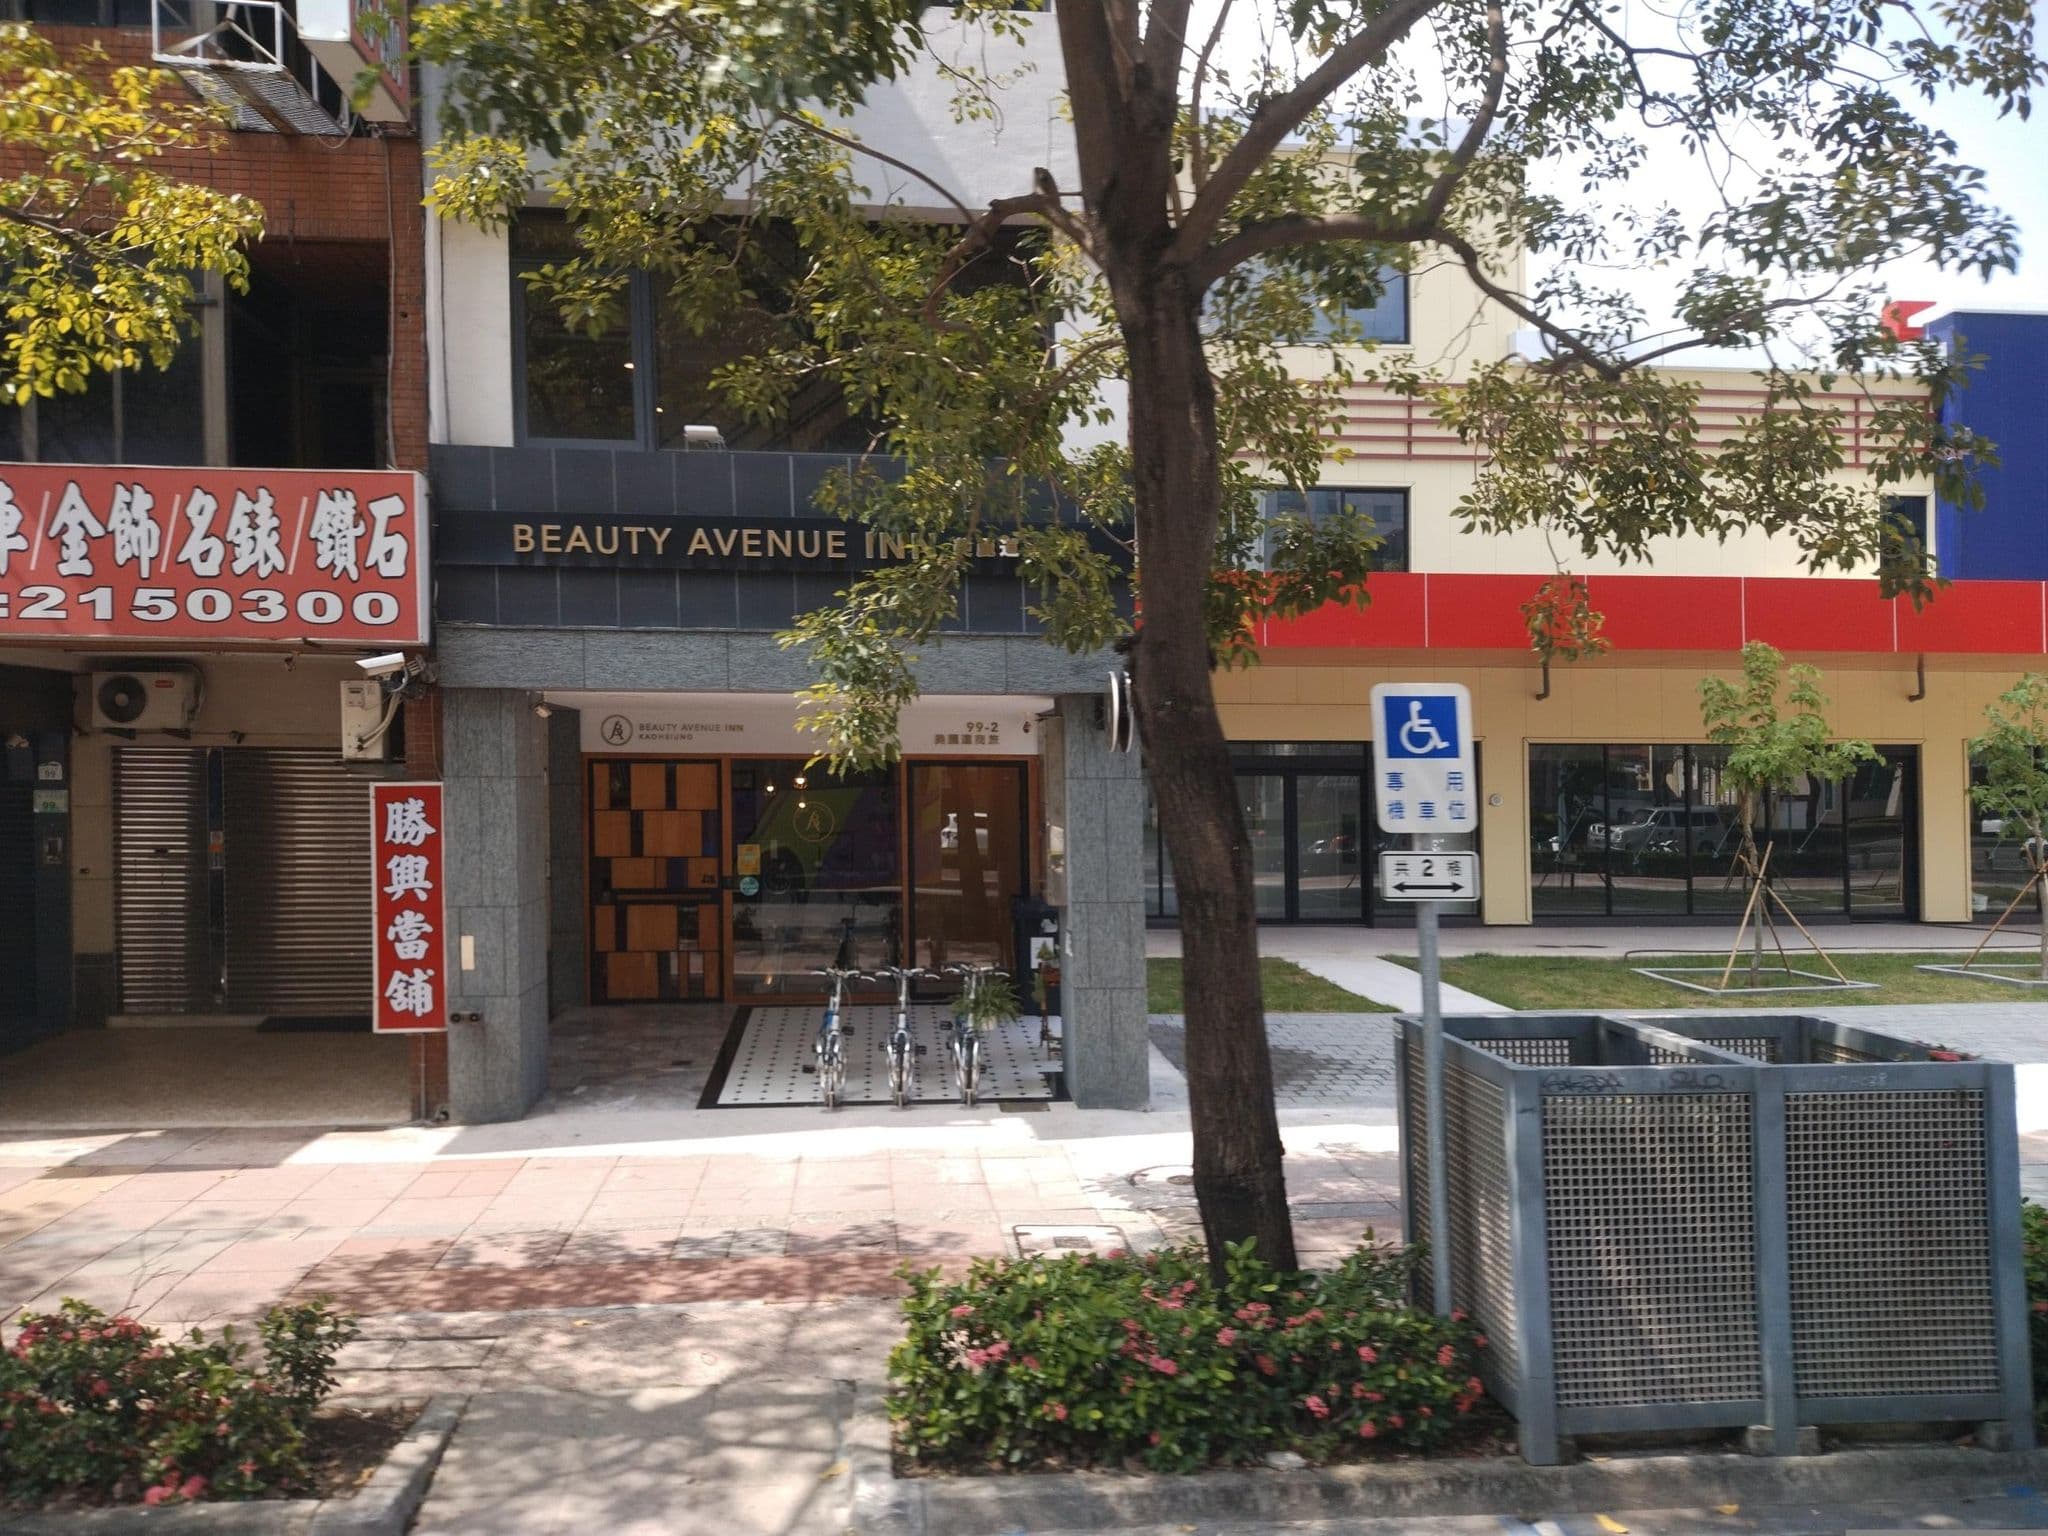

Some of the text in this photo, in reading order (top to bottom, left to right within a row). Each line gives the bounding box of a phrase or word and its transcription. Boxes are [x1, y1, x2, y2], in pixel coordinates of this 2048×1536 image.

[512, 524, 671, 555] BEAUTY
[687, 528, 847, 558] AVENUE
[639, 723, 744, 732] BEAUTY AVENUE INN
[966, 721, 998, 732] 99-2
